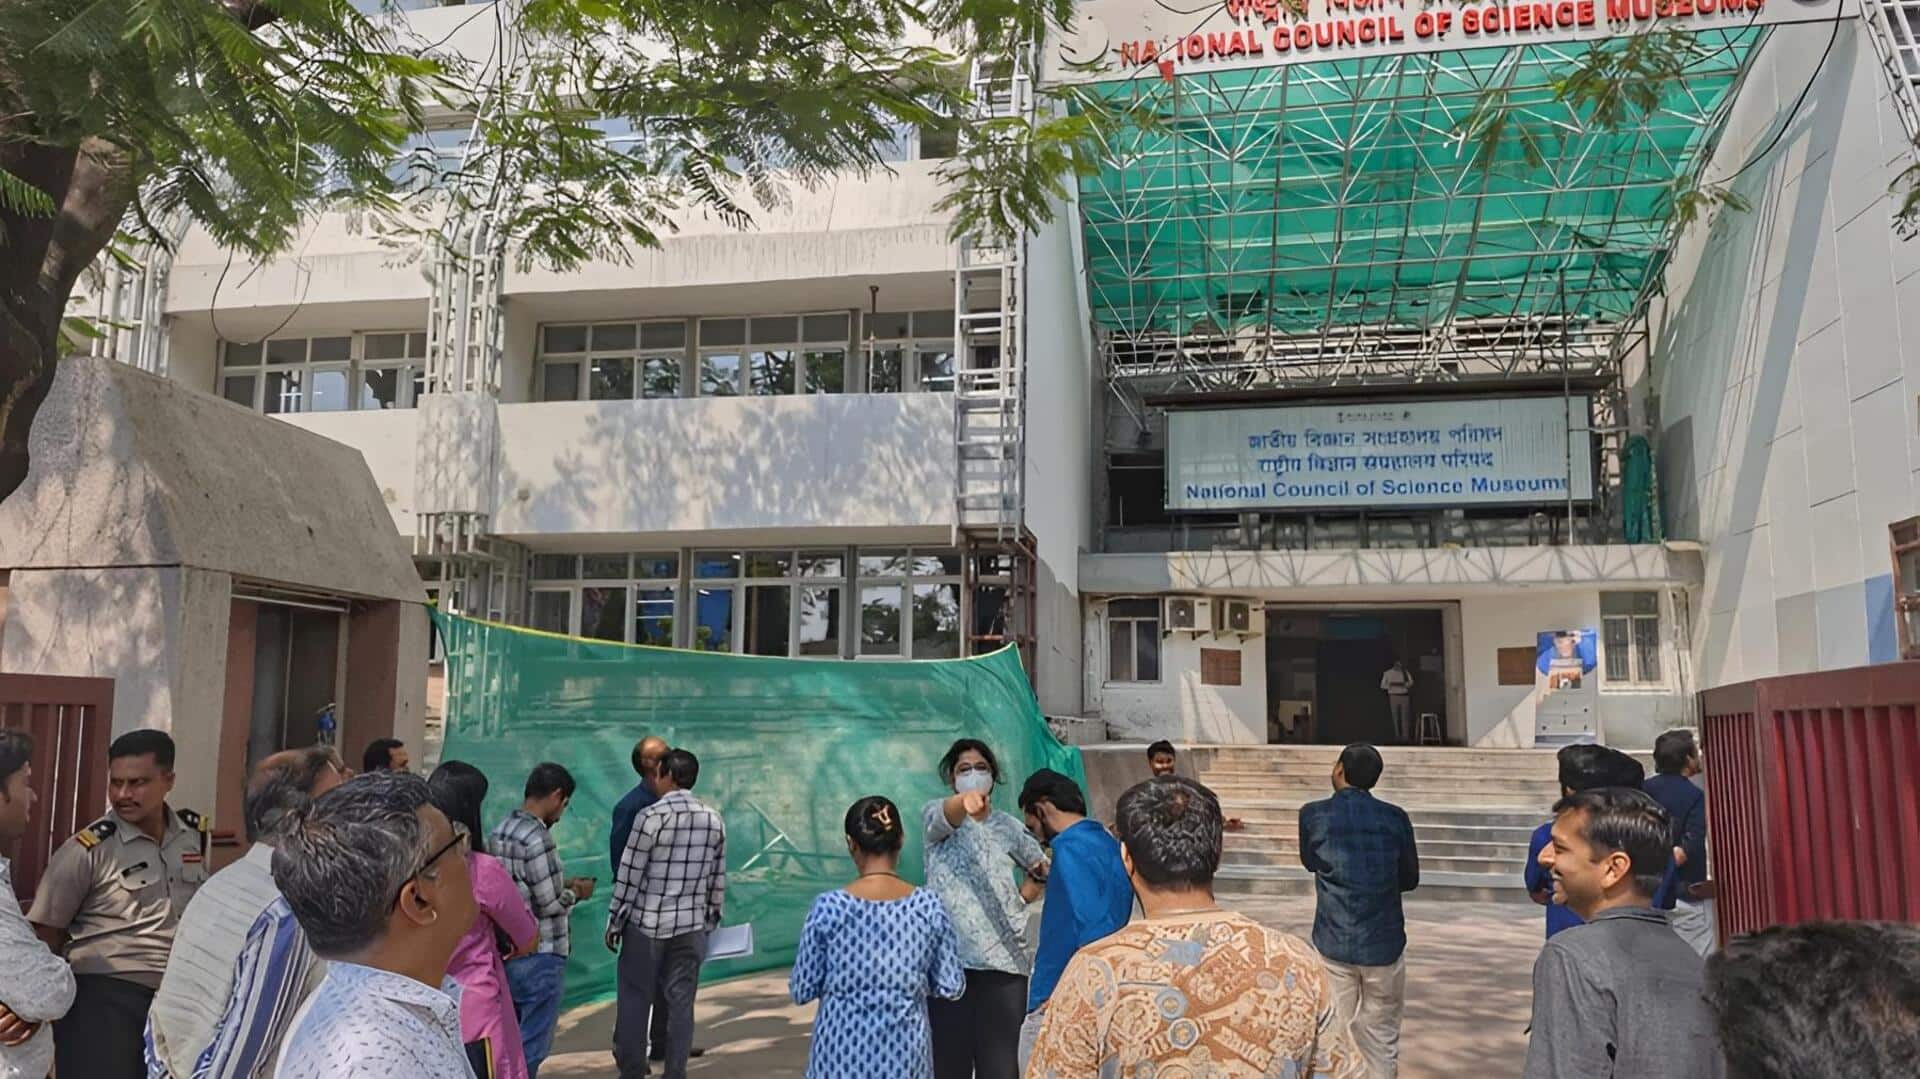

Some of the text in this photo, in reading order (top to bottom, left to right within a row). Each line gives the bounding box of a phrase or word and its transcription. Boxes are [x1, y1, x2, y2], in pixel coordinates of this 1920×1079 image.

[1120, 30, 1263, 67] NAIONAL
[1274, 17, 1404, 52] COUNCIL
[1415, 12, 1452, 40] OF
[1462, 1, 1597, 35] SCIENCE
[1186, 482, 1266, 500] National
[1272, 480, 1349, 498] Council
[1356, 480, 1375, 496] of
[1382, 478, 1463, 496] Science
